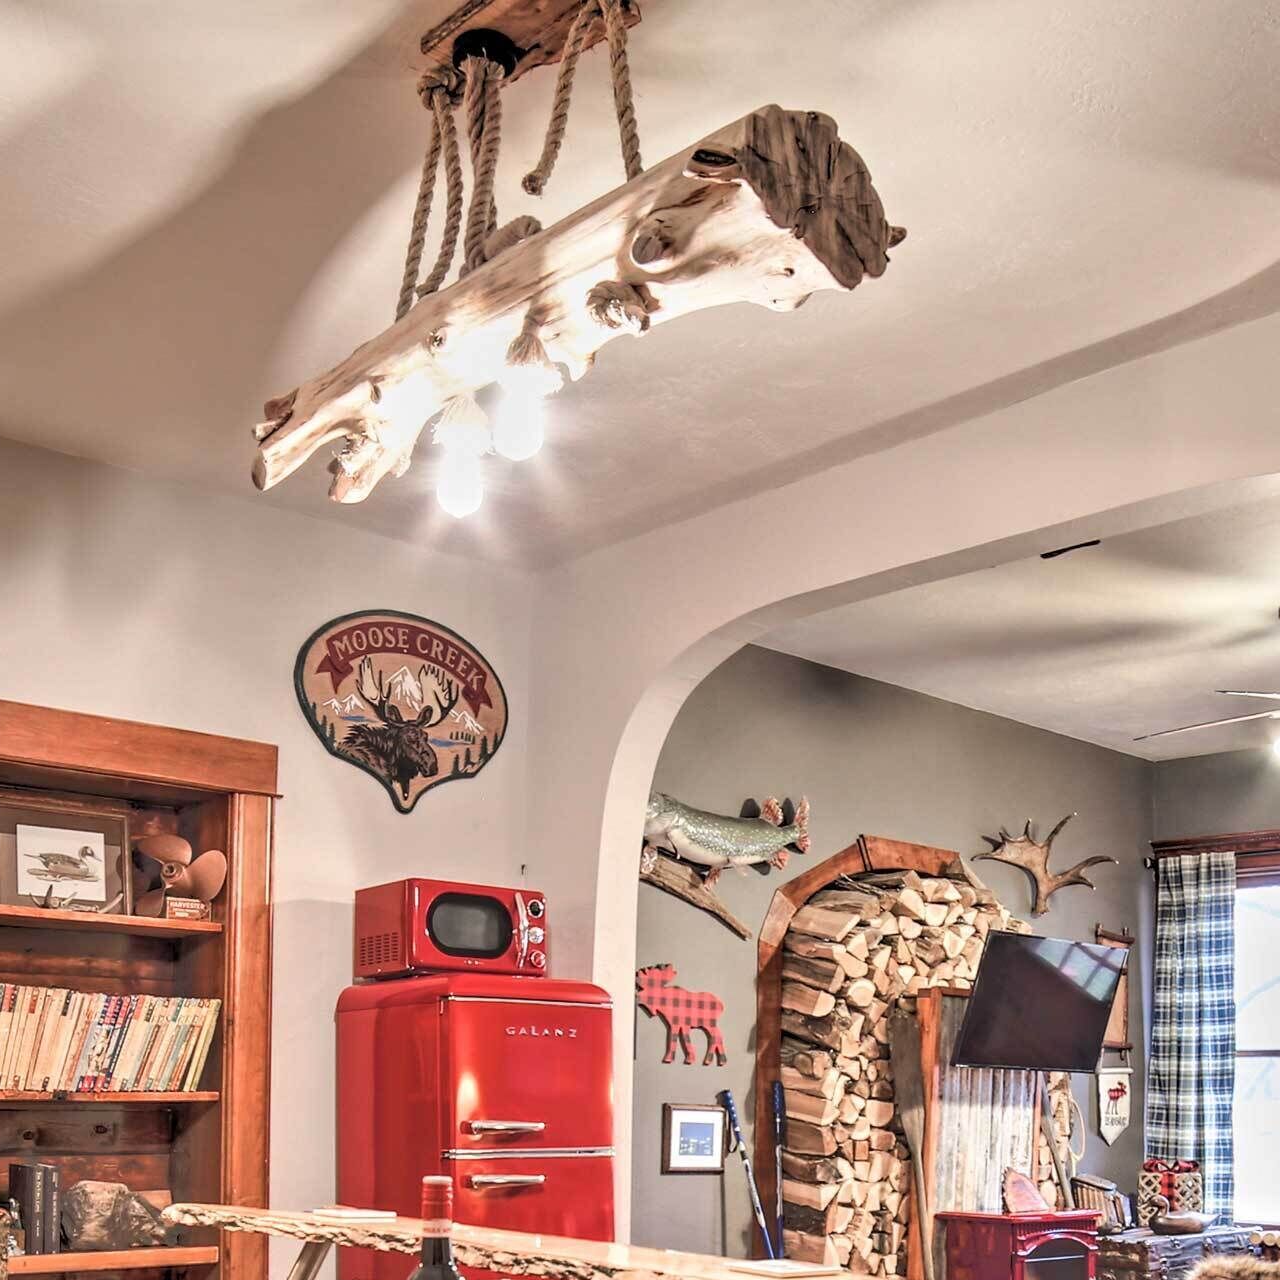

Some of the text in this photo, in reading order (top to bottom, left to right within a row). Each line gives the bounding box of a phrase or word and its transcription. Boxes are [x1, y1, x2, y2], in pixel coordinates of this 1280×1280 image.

[333, 627, 483, 689] MOOSE CREEK
[505, 1025, 577, 1038] GALANZ
